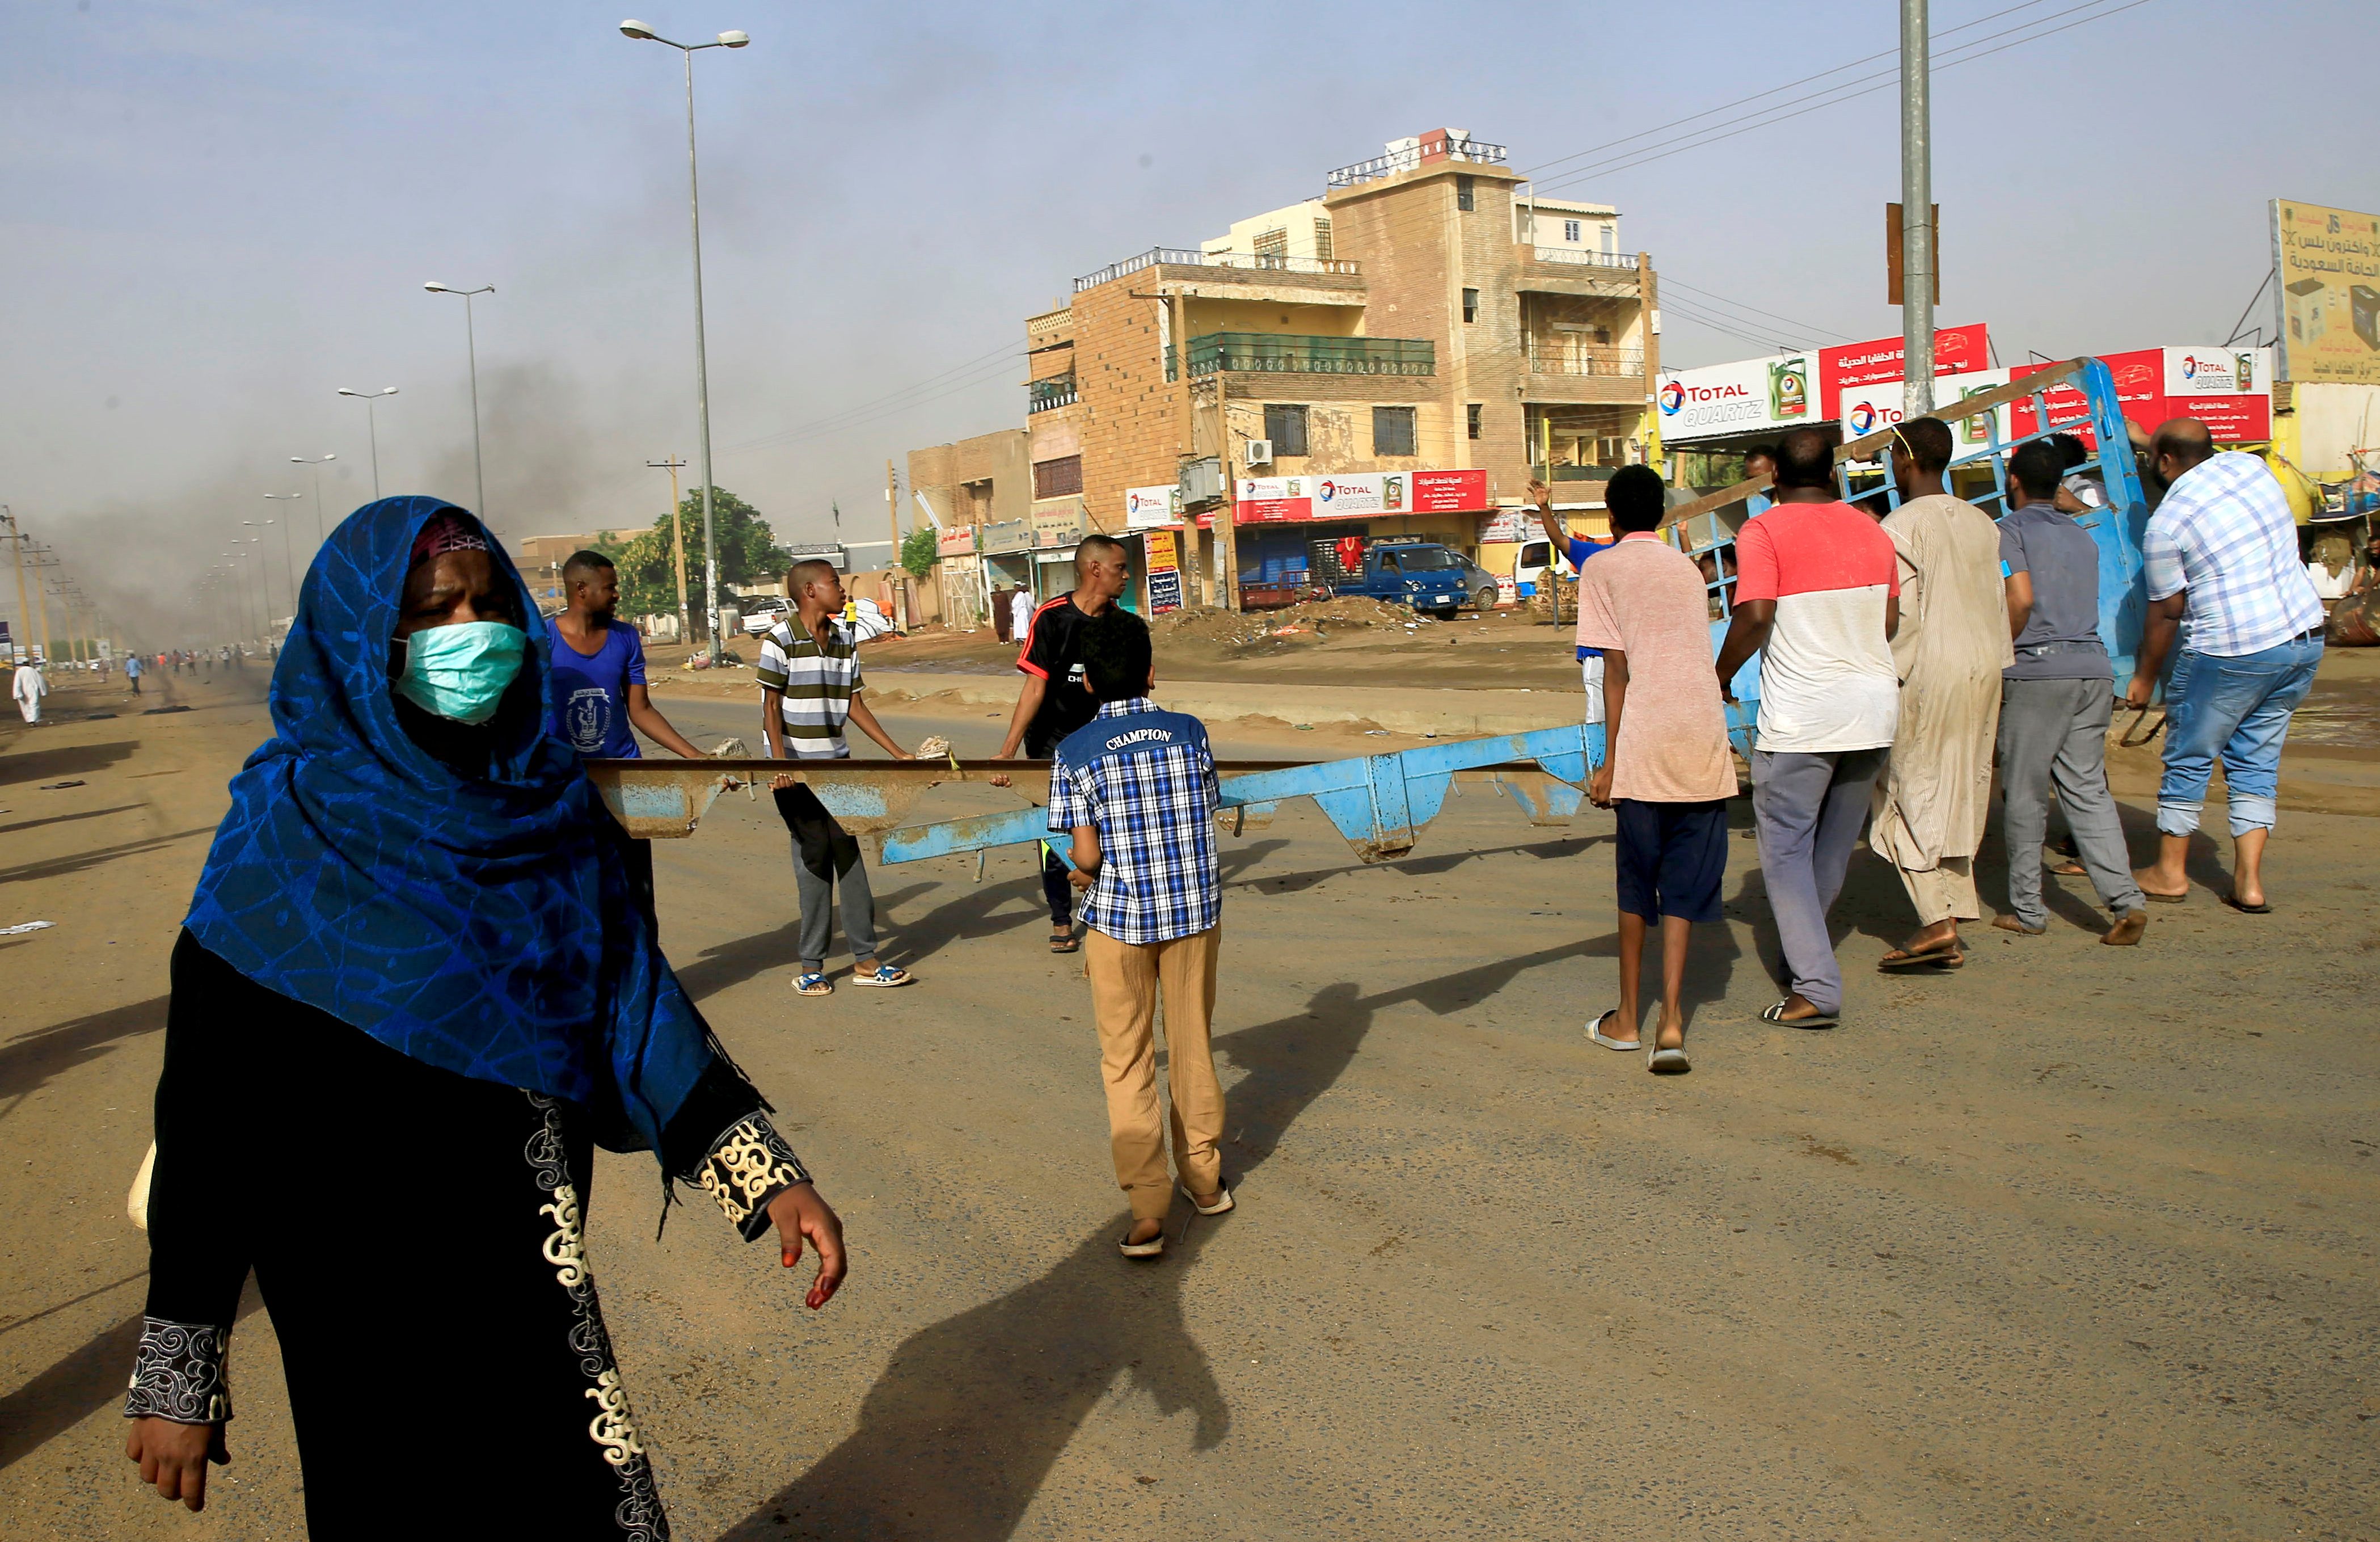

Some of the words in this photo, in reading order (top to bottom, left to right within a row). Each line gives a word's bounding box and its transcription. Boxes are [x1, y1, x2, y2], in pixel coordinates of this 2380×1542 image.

[2290, 251, 2345, 273] السعودية
[2197, 362, 2227, 372] TOTAL
[2195, 376, 2234, 389] QUARTZ
[1687, 384, 1749, 402] TOTAL
[1683, 399, 1765, 428] QUARTZ
[1336, 486, 1372, 495] TOTAL
[1140, 498, 1162, 507] TOTAL
[1335, 497, 1381, 510] QUARTZ
[1106, 728, 1172, 751] CHAMPION
